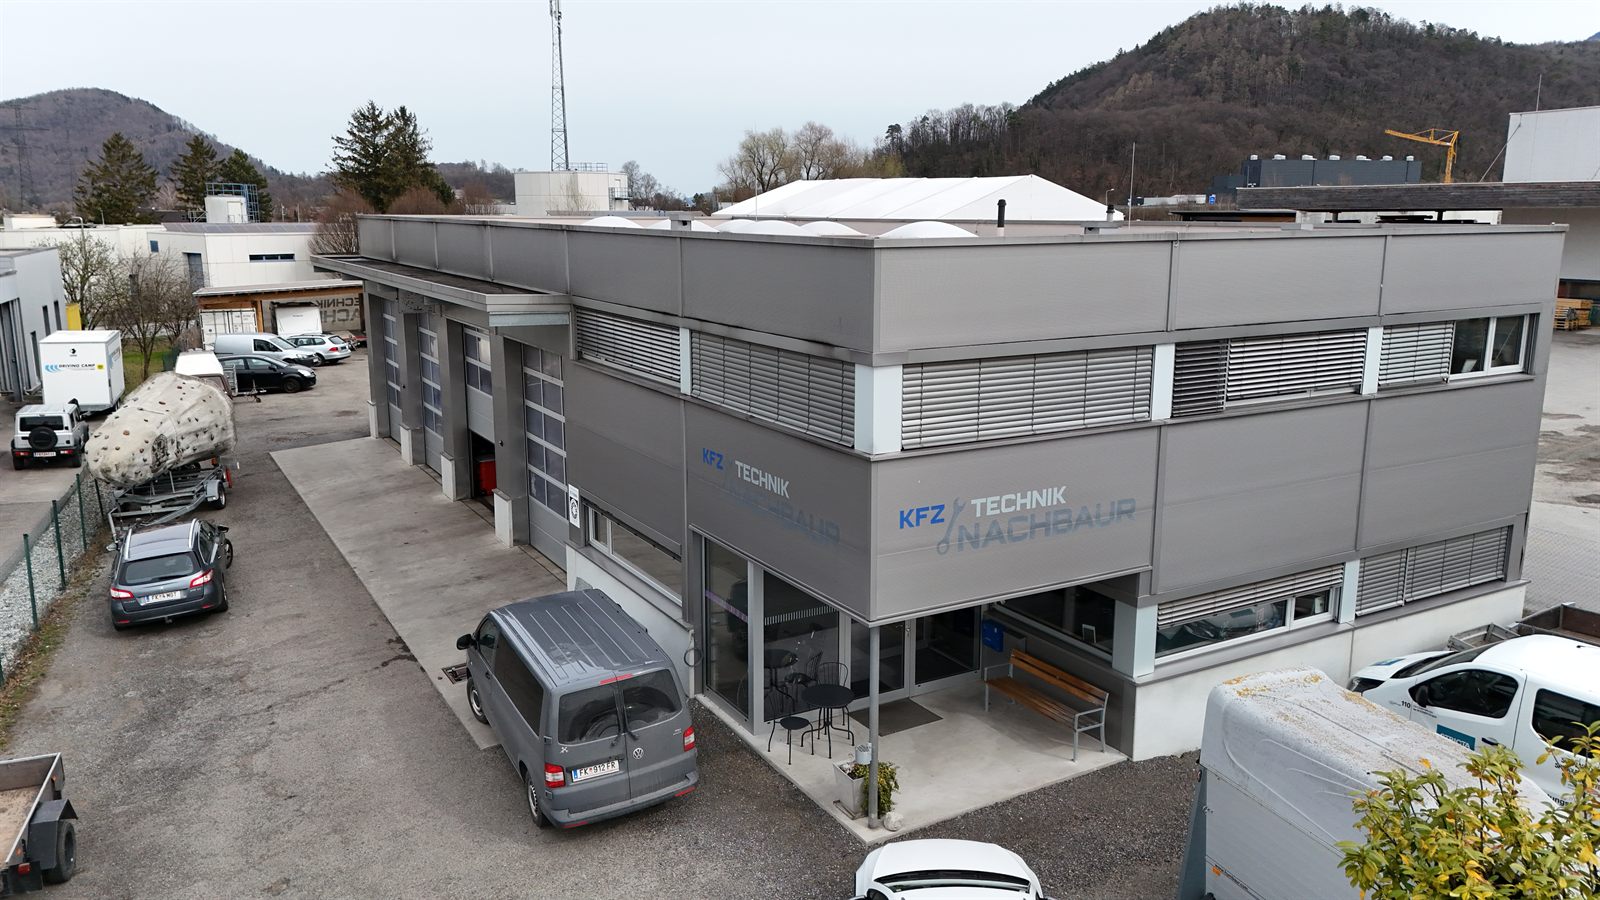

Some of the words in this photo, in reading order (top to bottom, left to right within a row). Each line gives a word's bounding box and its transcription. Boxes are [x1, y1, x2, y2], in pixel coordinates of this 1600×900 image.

[702, 447, 724, 470] KFZ
[735, 460, 790, 499] TECHNIK
[899, 504, 945, 529] KFZ
[971, 485, 1067, 517] TECHNIK
[957, 498, 1137, 552] NACHBAUR
[1401, 700, 1411, 709] 110
